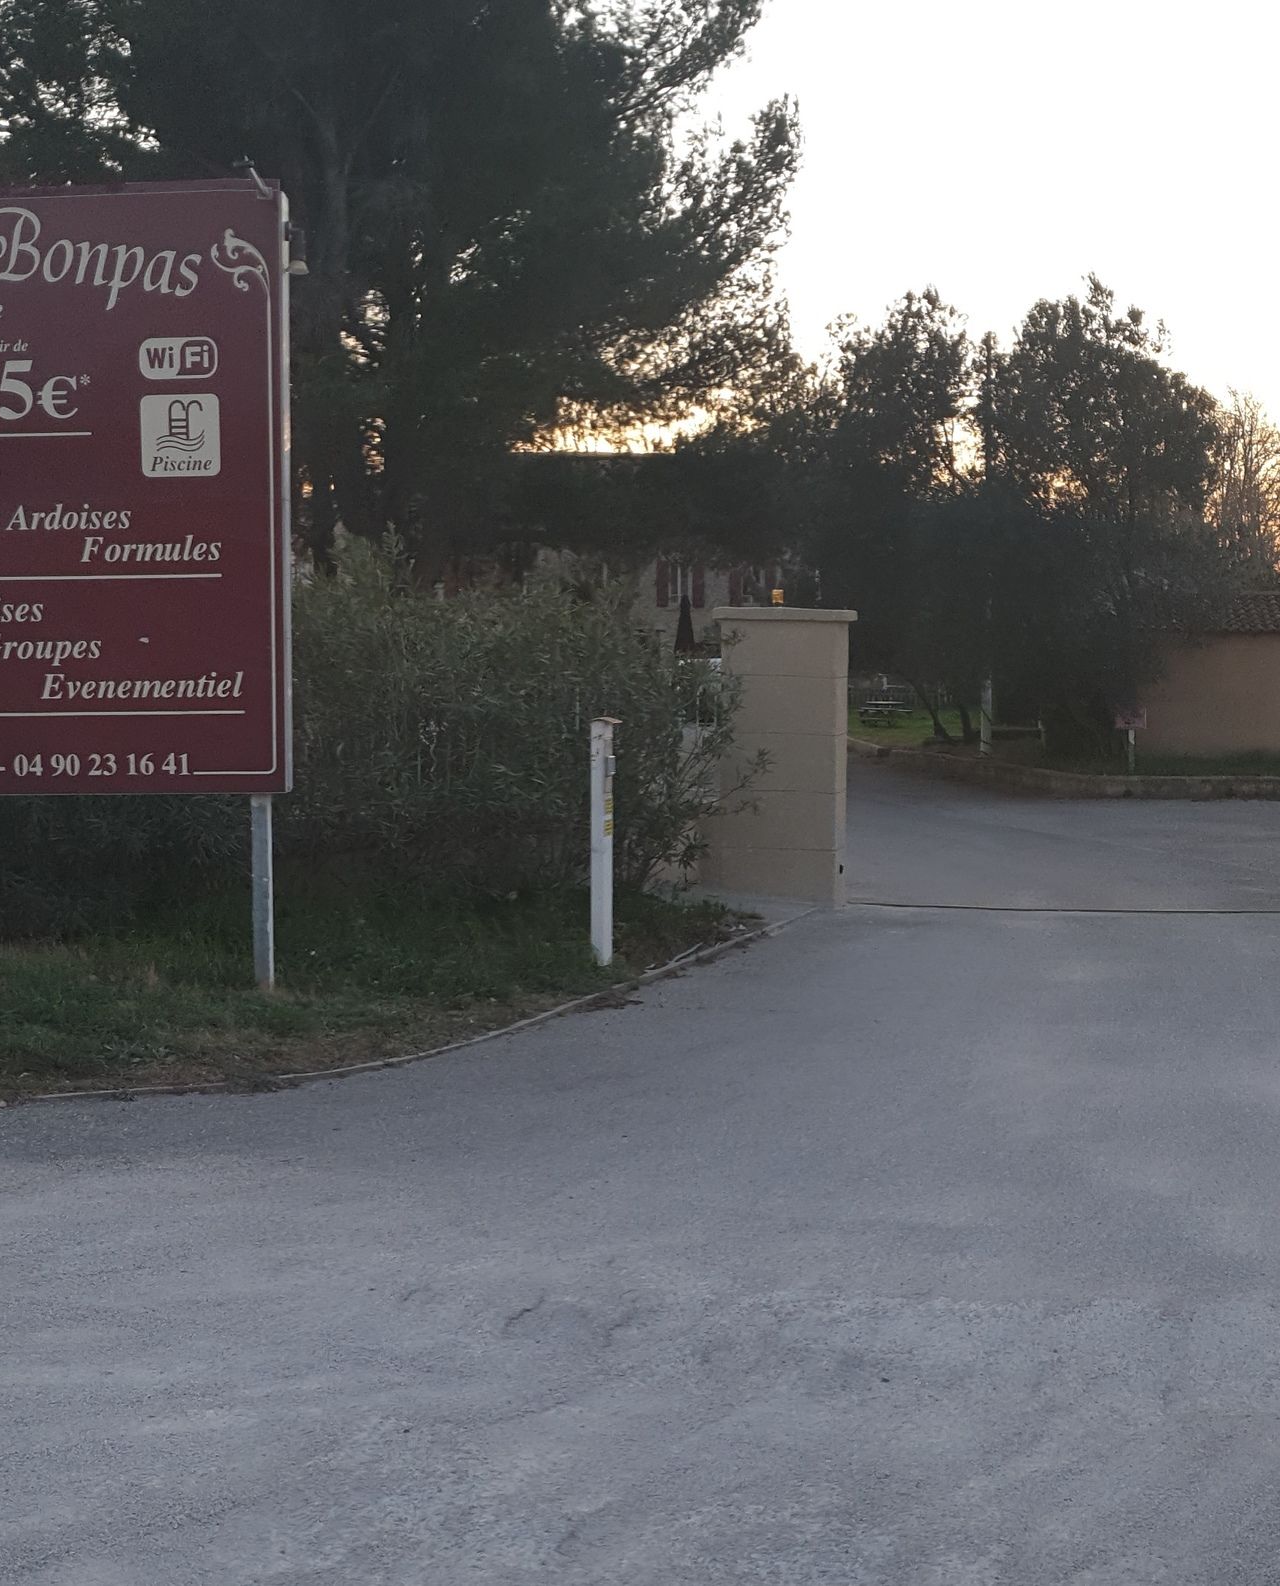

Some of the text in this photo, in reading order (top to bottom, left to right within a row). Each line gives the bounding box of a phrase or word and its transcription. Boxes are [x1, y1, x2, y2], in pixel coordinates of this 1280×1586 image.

[13, 339, 28, 353] de
[151, 456, 213, 472] Piscine
[5, 504, 131, 531] Ardoises
[80, 534, 222, 563] Formules
[41, 671, 244, 699] Evenementiel
[14, 754, 43, 777] 04
[51, 754, 81, 776] 90
[87, 754, 117, 776] 23
[126, 754, 154, 775] 16
[161, 753, 190, 775] 41
